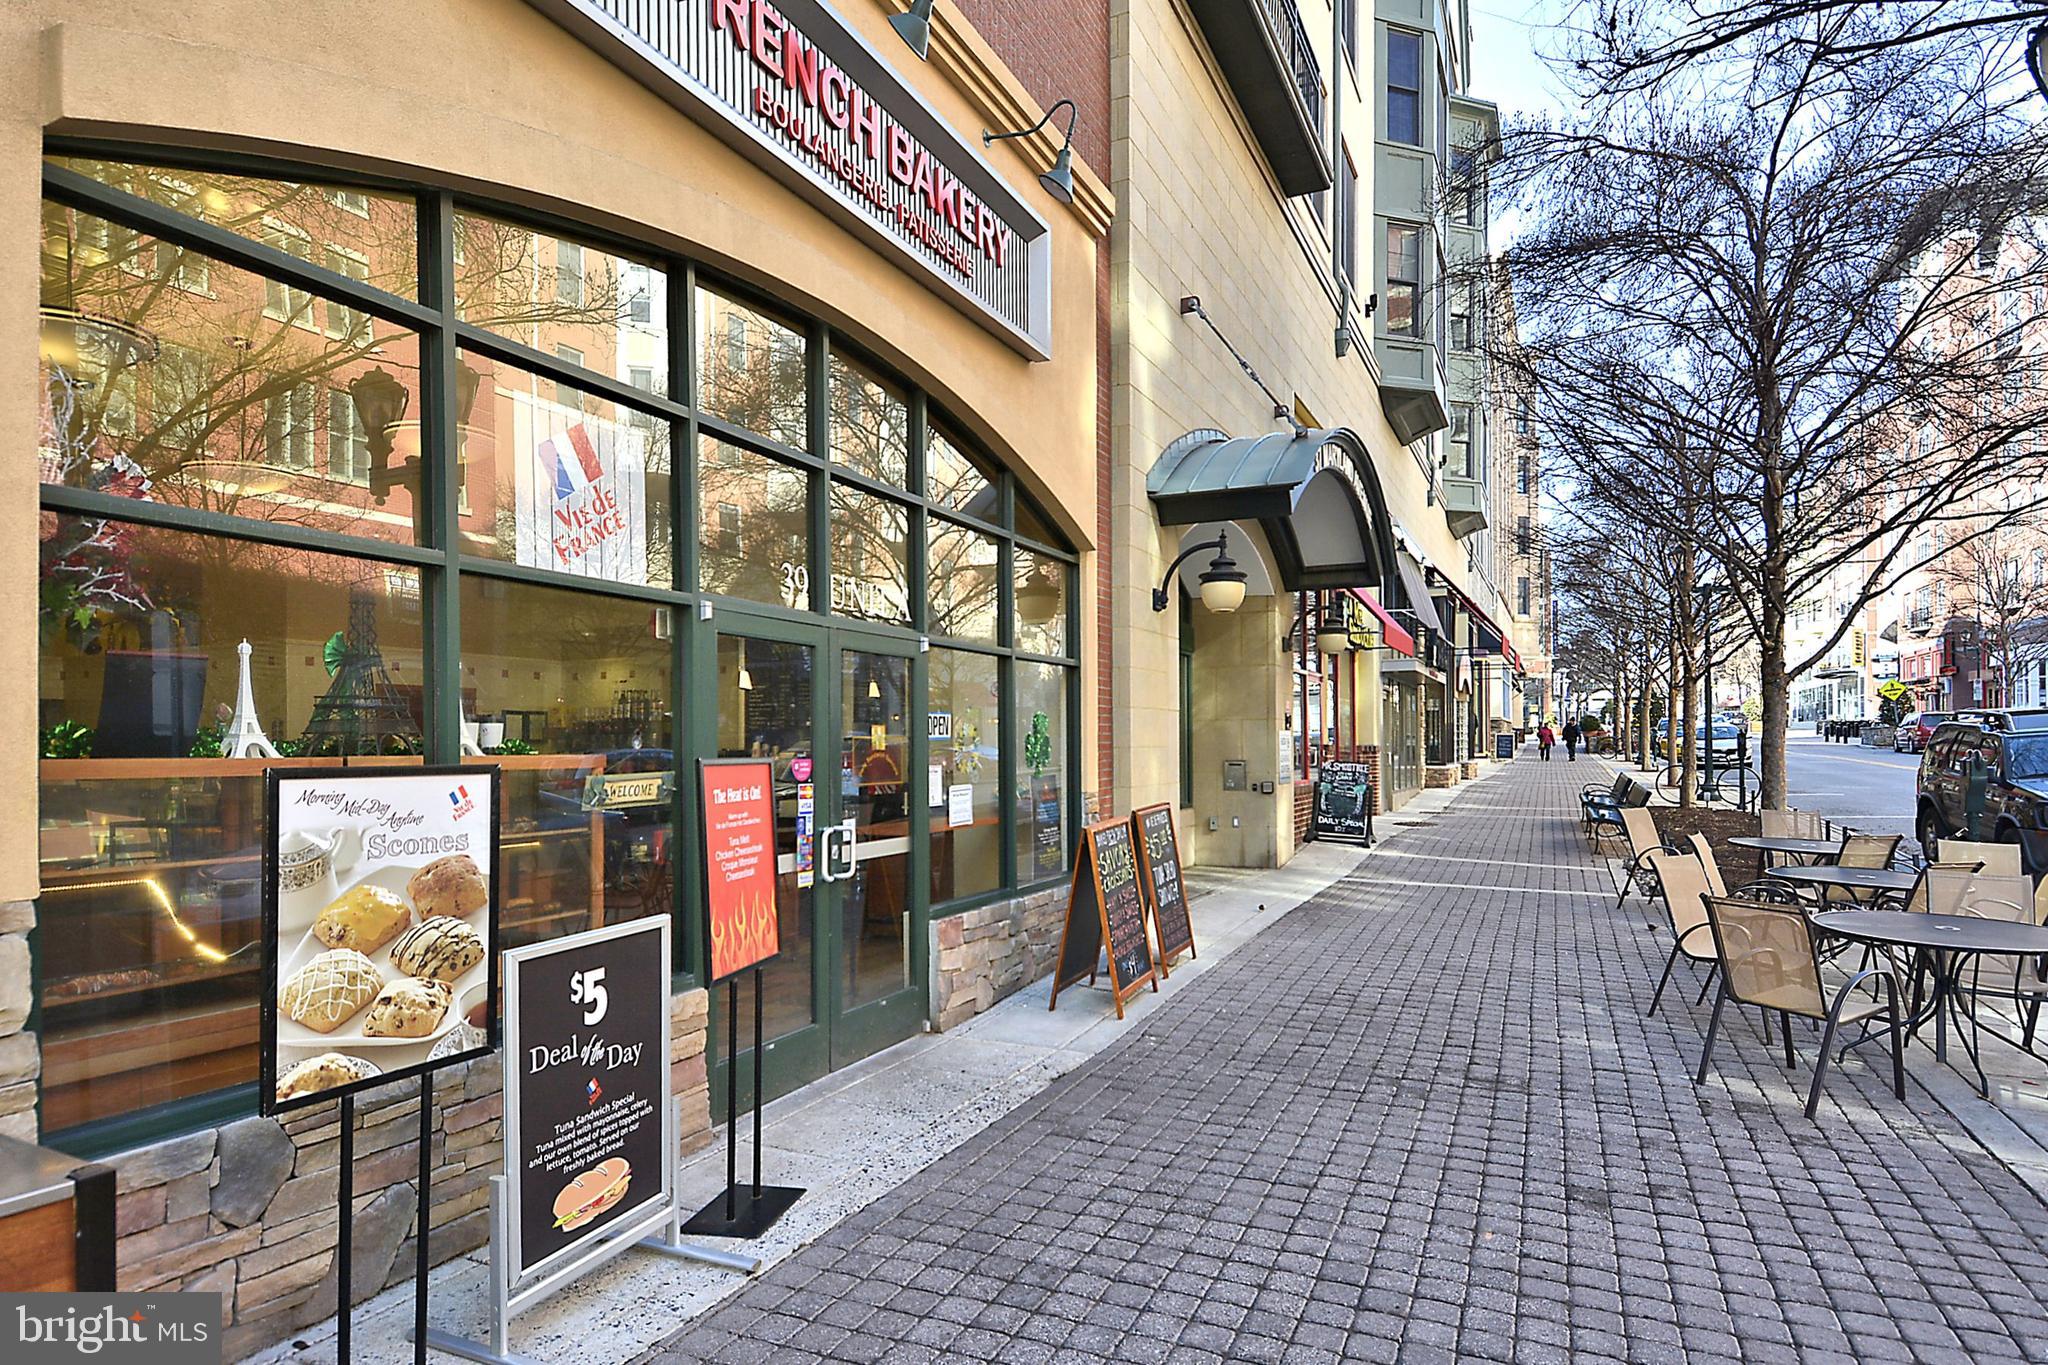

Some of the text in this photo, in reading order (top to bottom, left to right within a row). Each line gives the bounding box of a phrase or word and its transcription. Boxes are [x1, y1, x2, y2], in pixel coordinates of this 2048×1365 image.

[888, 123, 1012, 269] BAKERY
[928, 715, 950, 736] OPEN
[295, 789, 346, 810] Morning
[610, 783, 654, 798] WELCOME
[713, 788, 726, 804] The
[727, 787, 742, 803] Heat
[339, 798, 391, 820] Mid-Day
[380, 809, 425, 832] Anytime
[1318, 816, 1339, 825] DAILY
[367, 833, 470, 861] Scones
[570, 966, 609, 1026] $5
[529, 1034, 578, 1074] Deal
[606, 1042, 643, 1070] Day
[536, 1098, 648, 1154] Tuna mixed with mayonnaise, celery
[555, 1120, 574, 1135] Tuna
[576, 1104, 610, 1126] Sandwich
[612, 1091, 635, 1111] Special
[528, 1105, 653, 1169] and our own blend of spices topped with
[546, 1155, 572, 1172] lettuce,
[599, 1131, 620, 1147] Served
[629, 1121, 640, 1132] our
[563, 1138, 625, 1174] freshly baked bread.
